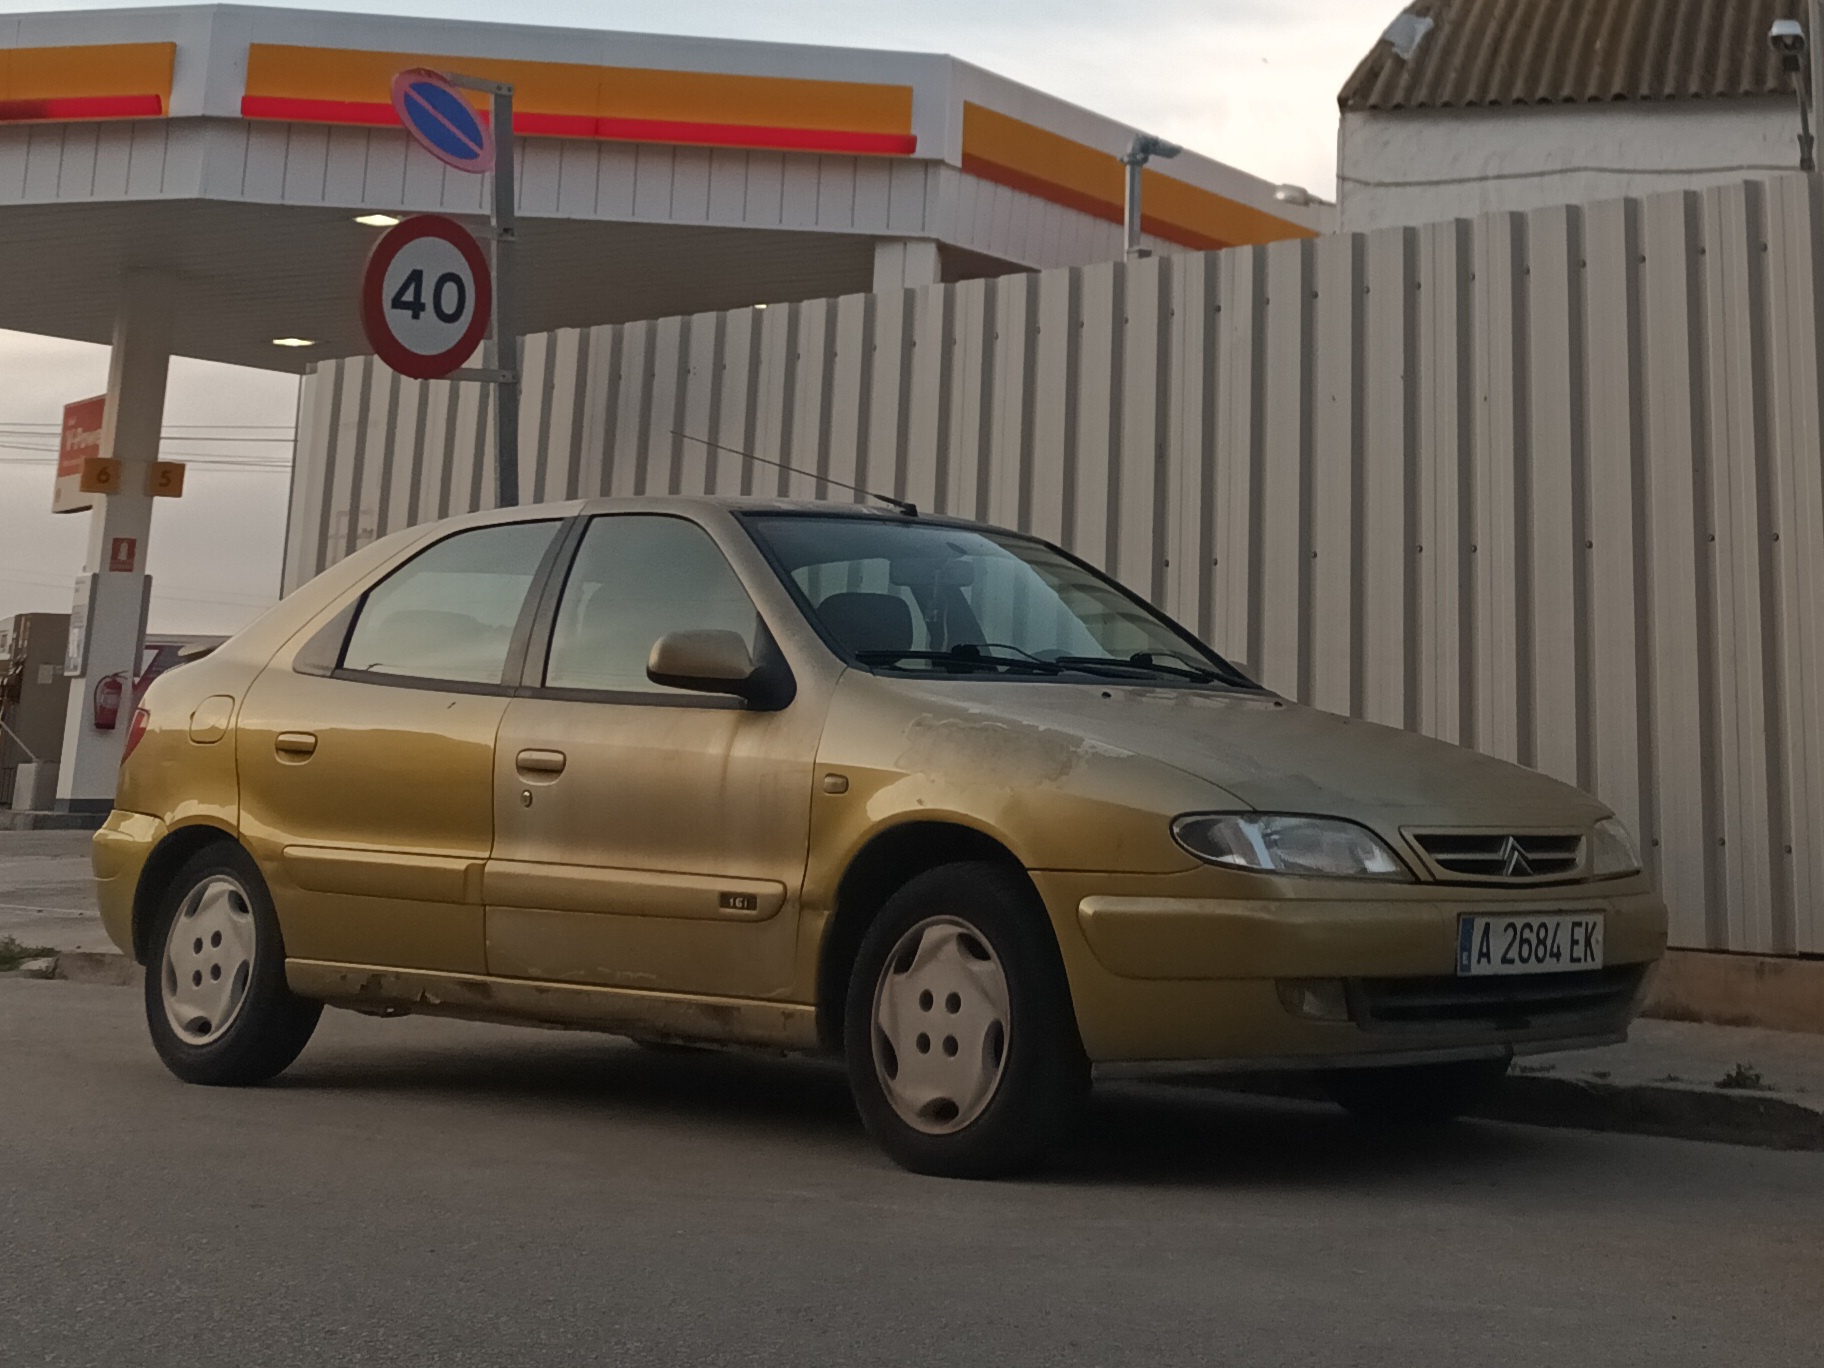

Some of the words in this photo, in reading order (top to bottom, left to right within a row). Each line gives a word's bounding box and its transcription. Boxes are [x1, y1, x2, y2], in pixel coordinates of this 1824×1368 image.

[391, 269, 466, 324] 40
[96, 466, 111, 484] 6
[158, 470, 172, 487] 5
[1477, 922, 1492, 965] A
[1500, 922, 1562, 965] 2684
[1569, 921, 1597, 964] EK
